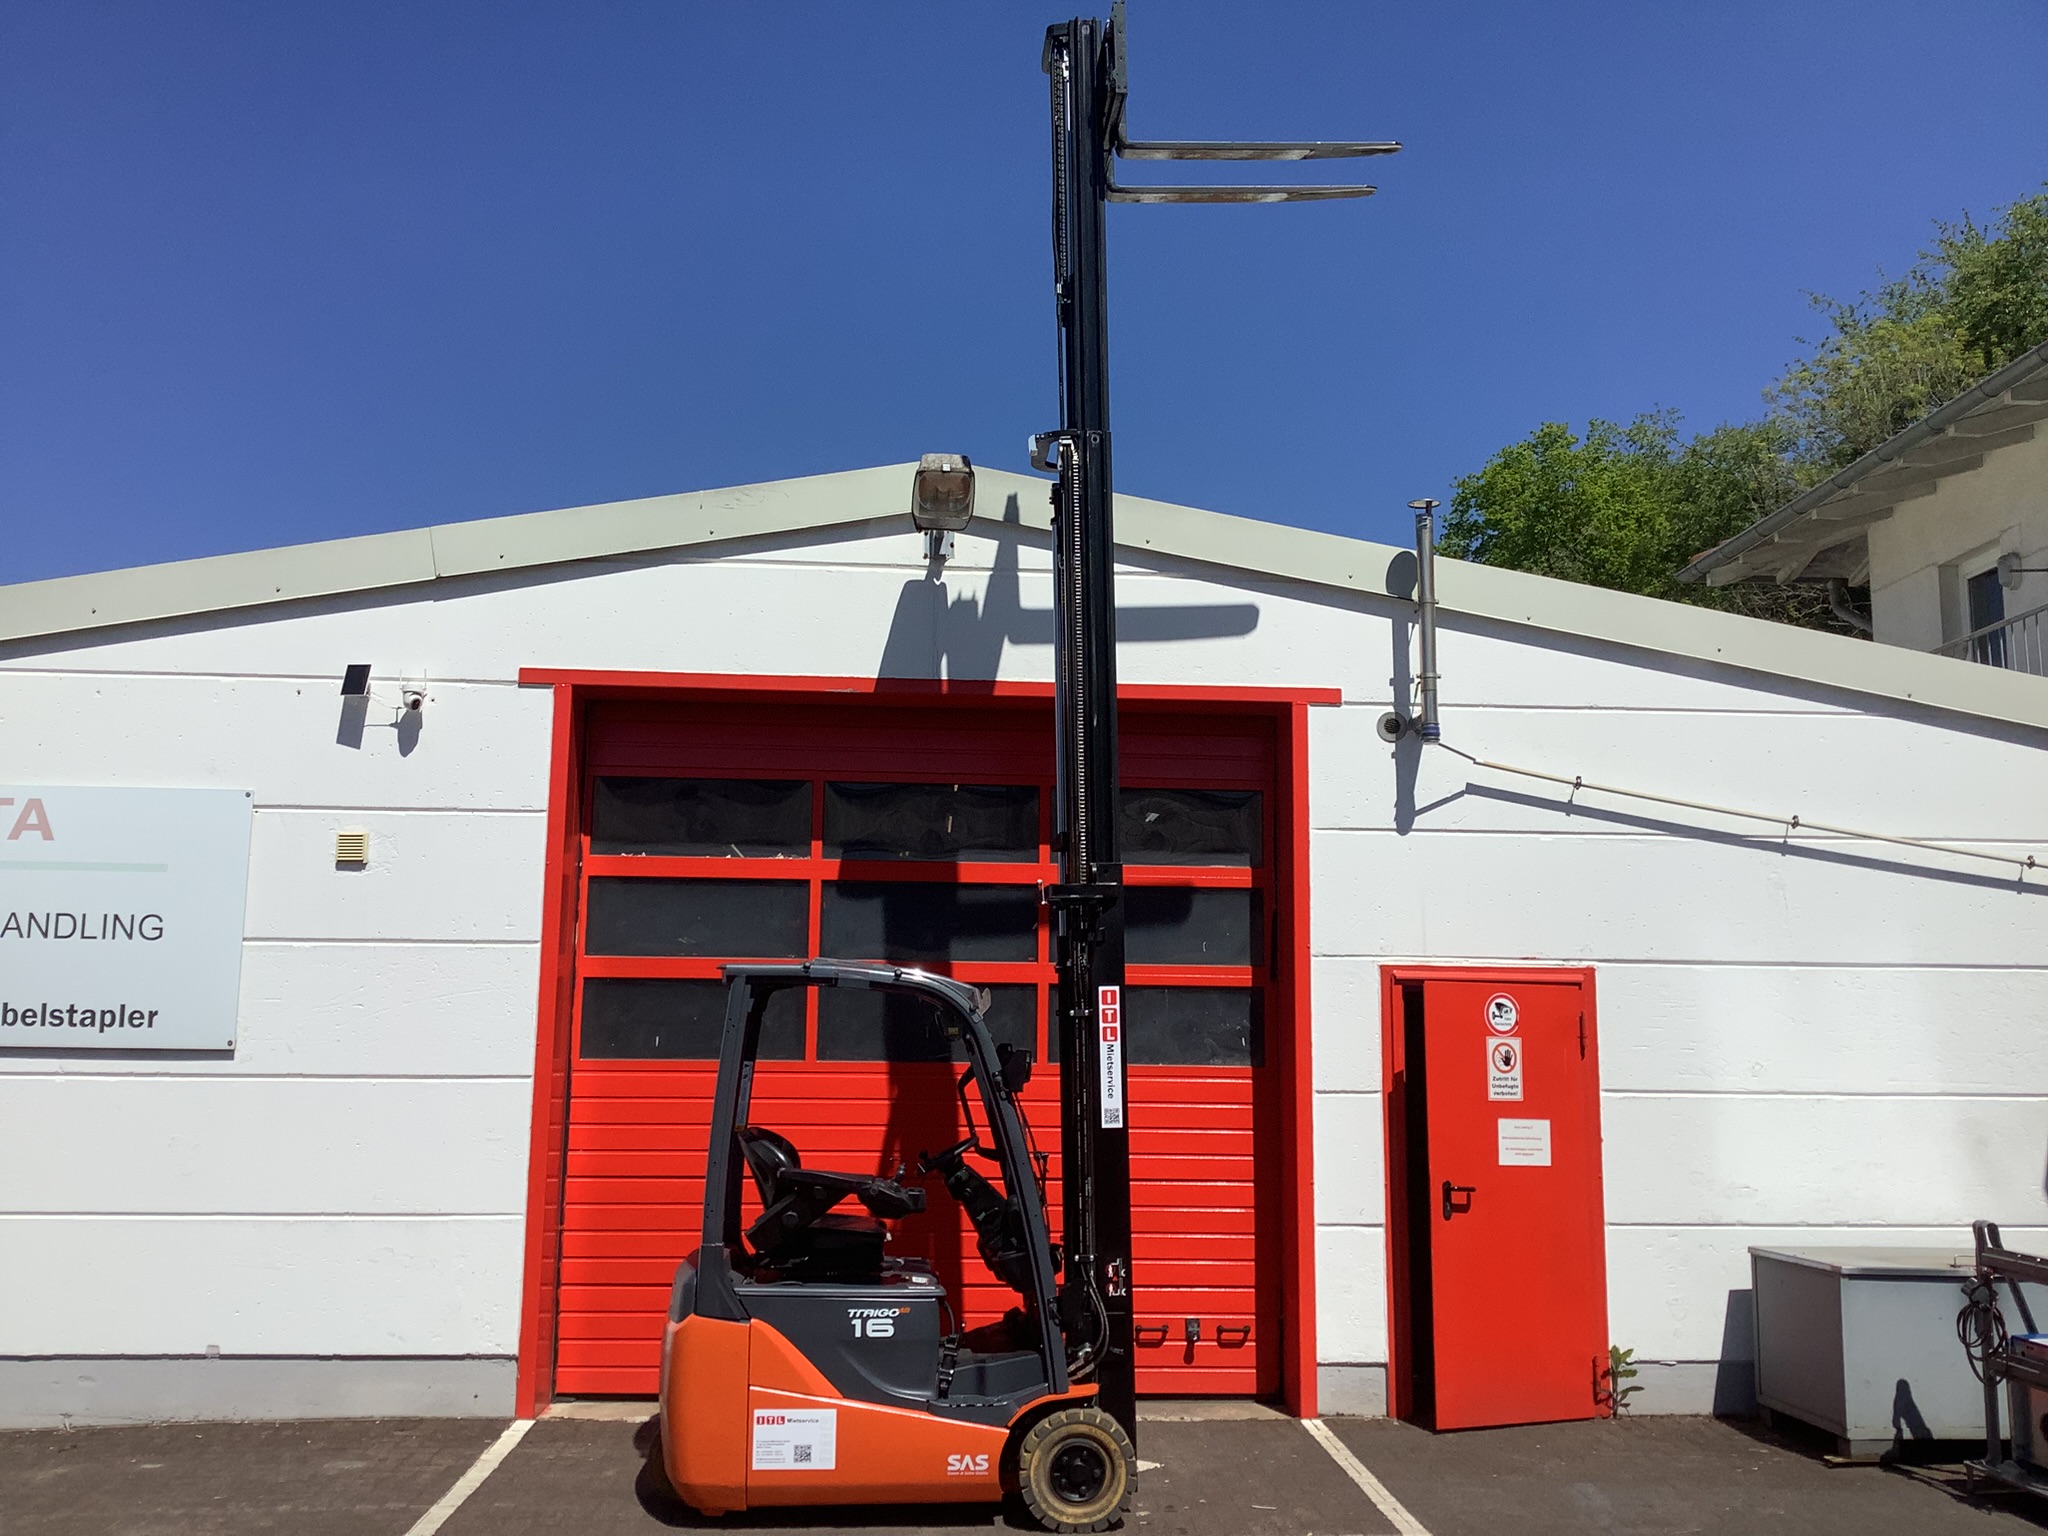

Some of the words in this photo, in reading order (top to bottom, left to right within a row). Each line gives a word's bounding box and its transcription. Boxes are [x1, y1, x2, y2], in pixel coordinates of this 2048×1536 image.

[0, 911, 165, 940] ANDLING
[1, 1001, 159, 1033] belstapler
[1103, 991, 1117, 1041] ITL
[1106, 1043, 1116, 1099] Mietservice
[851, 1318, 895, 1338] 16
[757, 1416, 785, 1425] ITL
[947, 1454, 989, 1471] SAS
